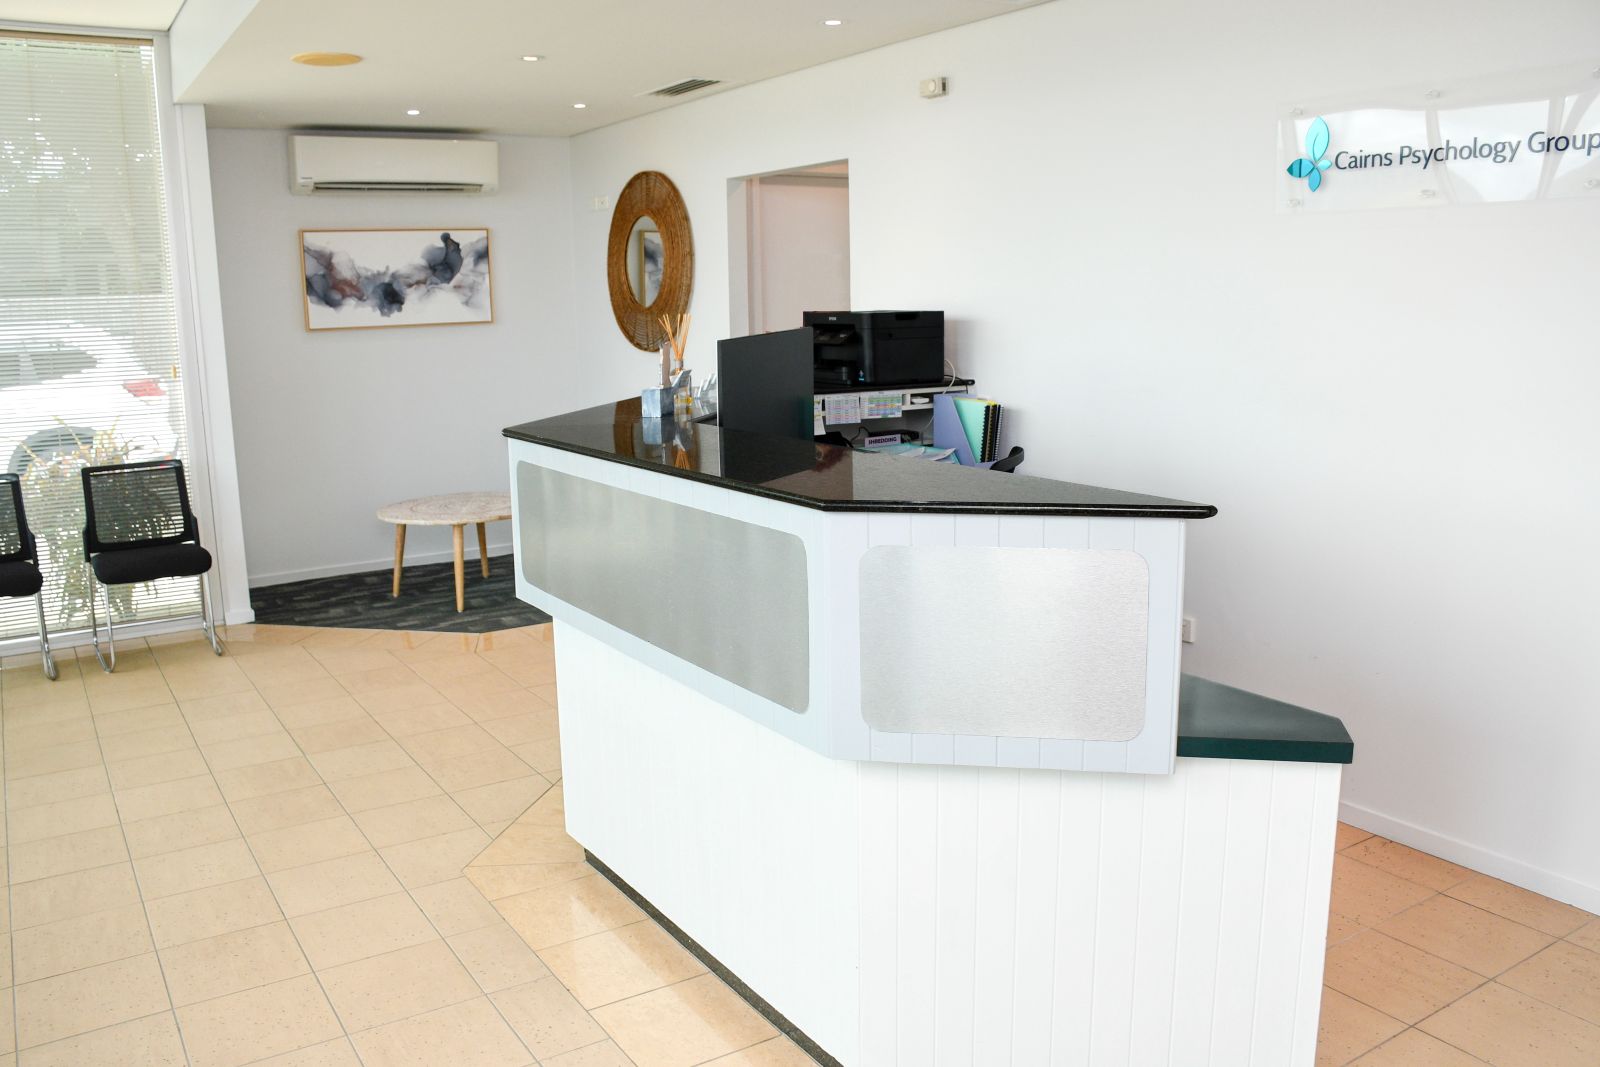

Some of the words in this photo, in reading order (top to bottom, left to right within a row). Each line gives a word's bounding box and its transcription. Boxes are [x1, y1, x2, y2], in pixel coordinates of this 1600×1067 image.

[1335, 150, 1393, 170] Cairns
[1399, 137, 1521, 170] Psychology
[1527, 131, 1600, 155] Group
